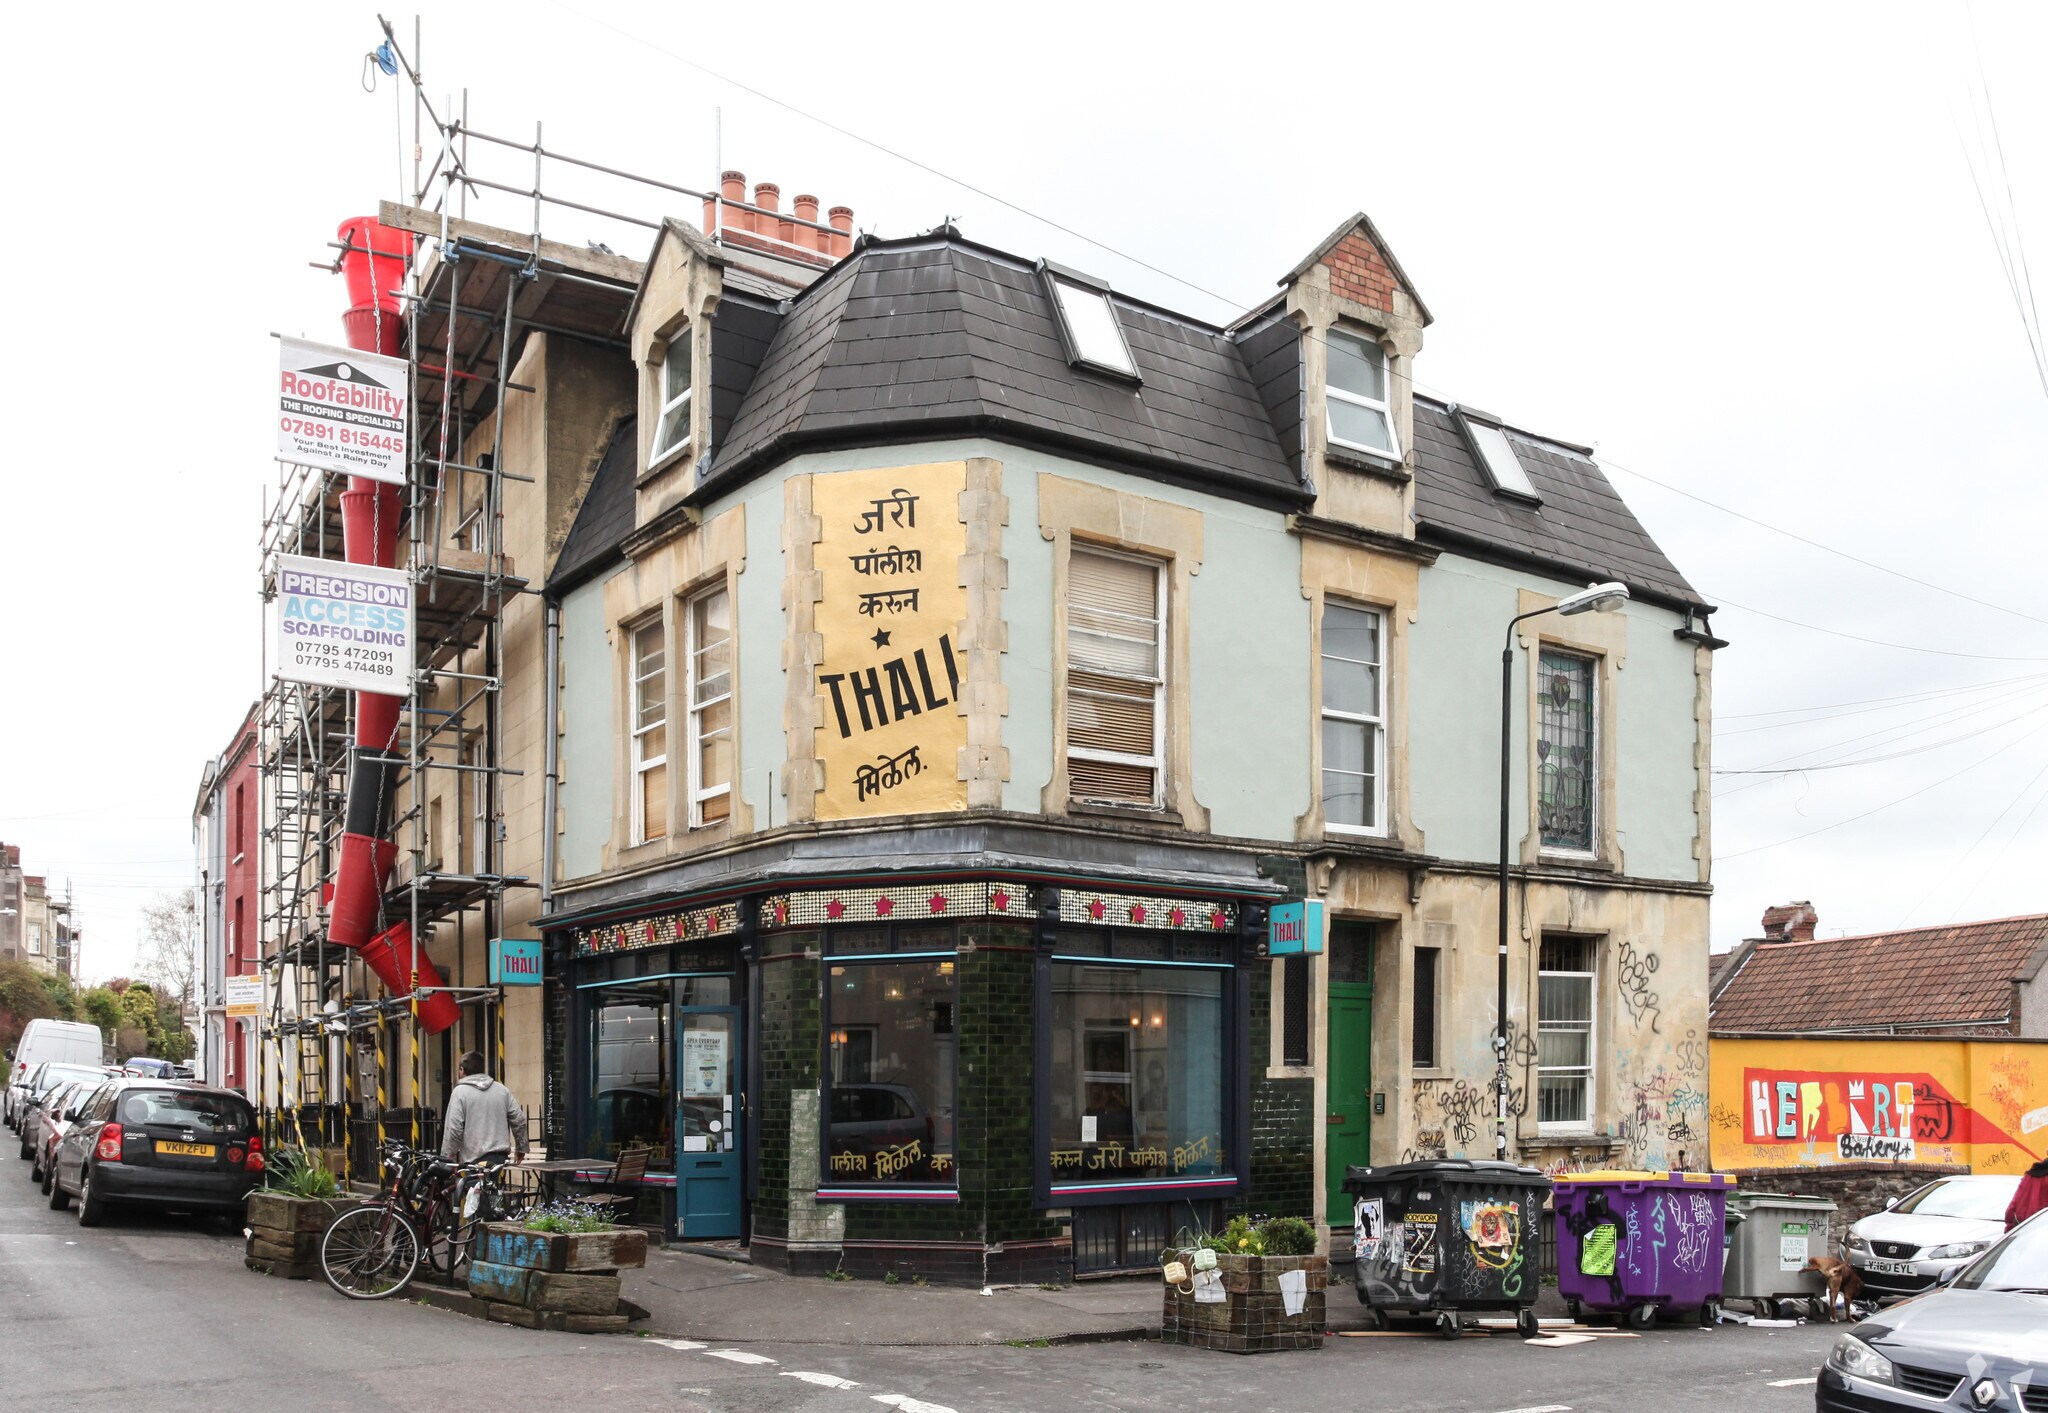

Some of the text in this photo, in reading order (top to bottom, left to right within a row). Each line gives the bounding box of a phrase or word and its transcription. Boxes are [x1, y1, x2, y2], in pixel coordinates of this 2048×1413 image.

[282, 371, 404, 419] Roofability
[282, 400, 402, 430] THE ROOFING SPECIALISTS
[281, 417, 404, 453] 07891 815445
[293, 437, 392, 460] Your Best Investment
[297, 445, 332, 458] Against
[343, 454, 368, 464] Rainy
[370, 458, 388, 468] Day
[854, 488, 920, 534] जरी
[848, 545, 922, 576] पॉलीश
[286, 573, 404, 606] PRECISION
[284, 596, 406, 632] ACCESS
[284, 620, 406, 648] SCAFFOLDING
[296, 641, 393, 662] 07795 472091
[296, 654, 394, 676] 07795 474489
[819, 633, 960, 739] THALI
[1273, 919, 1302, 943] THALI
[504, 954, 539, 974] THALI
[165, 1142, 207, 1155] VK11 ZFU
[1087, 1141, 1125, 1170] जरी
[1840, 1134, 1902, 1163] Bakery
[1404, 1214, 1437, 1222] BODYWORK
[1894, 1264, 1913, 1274] EYL
